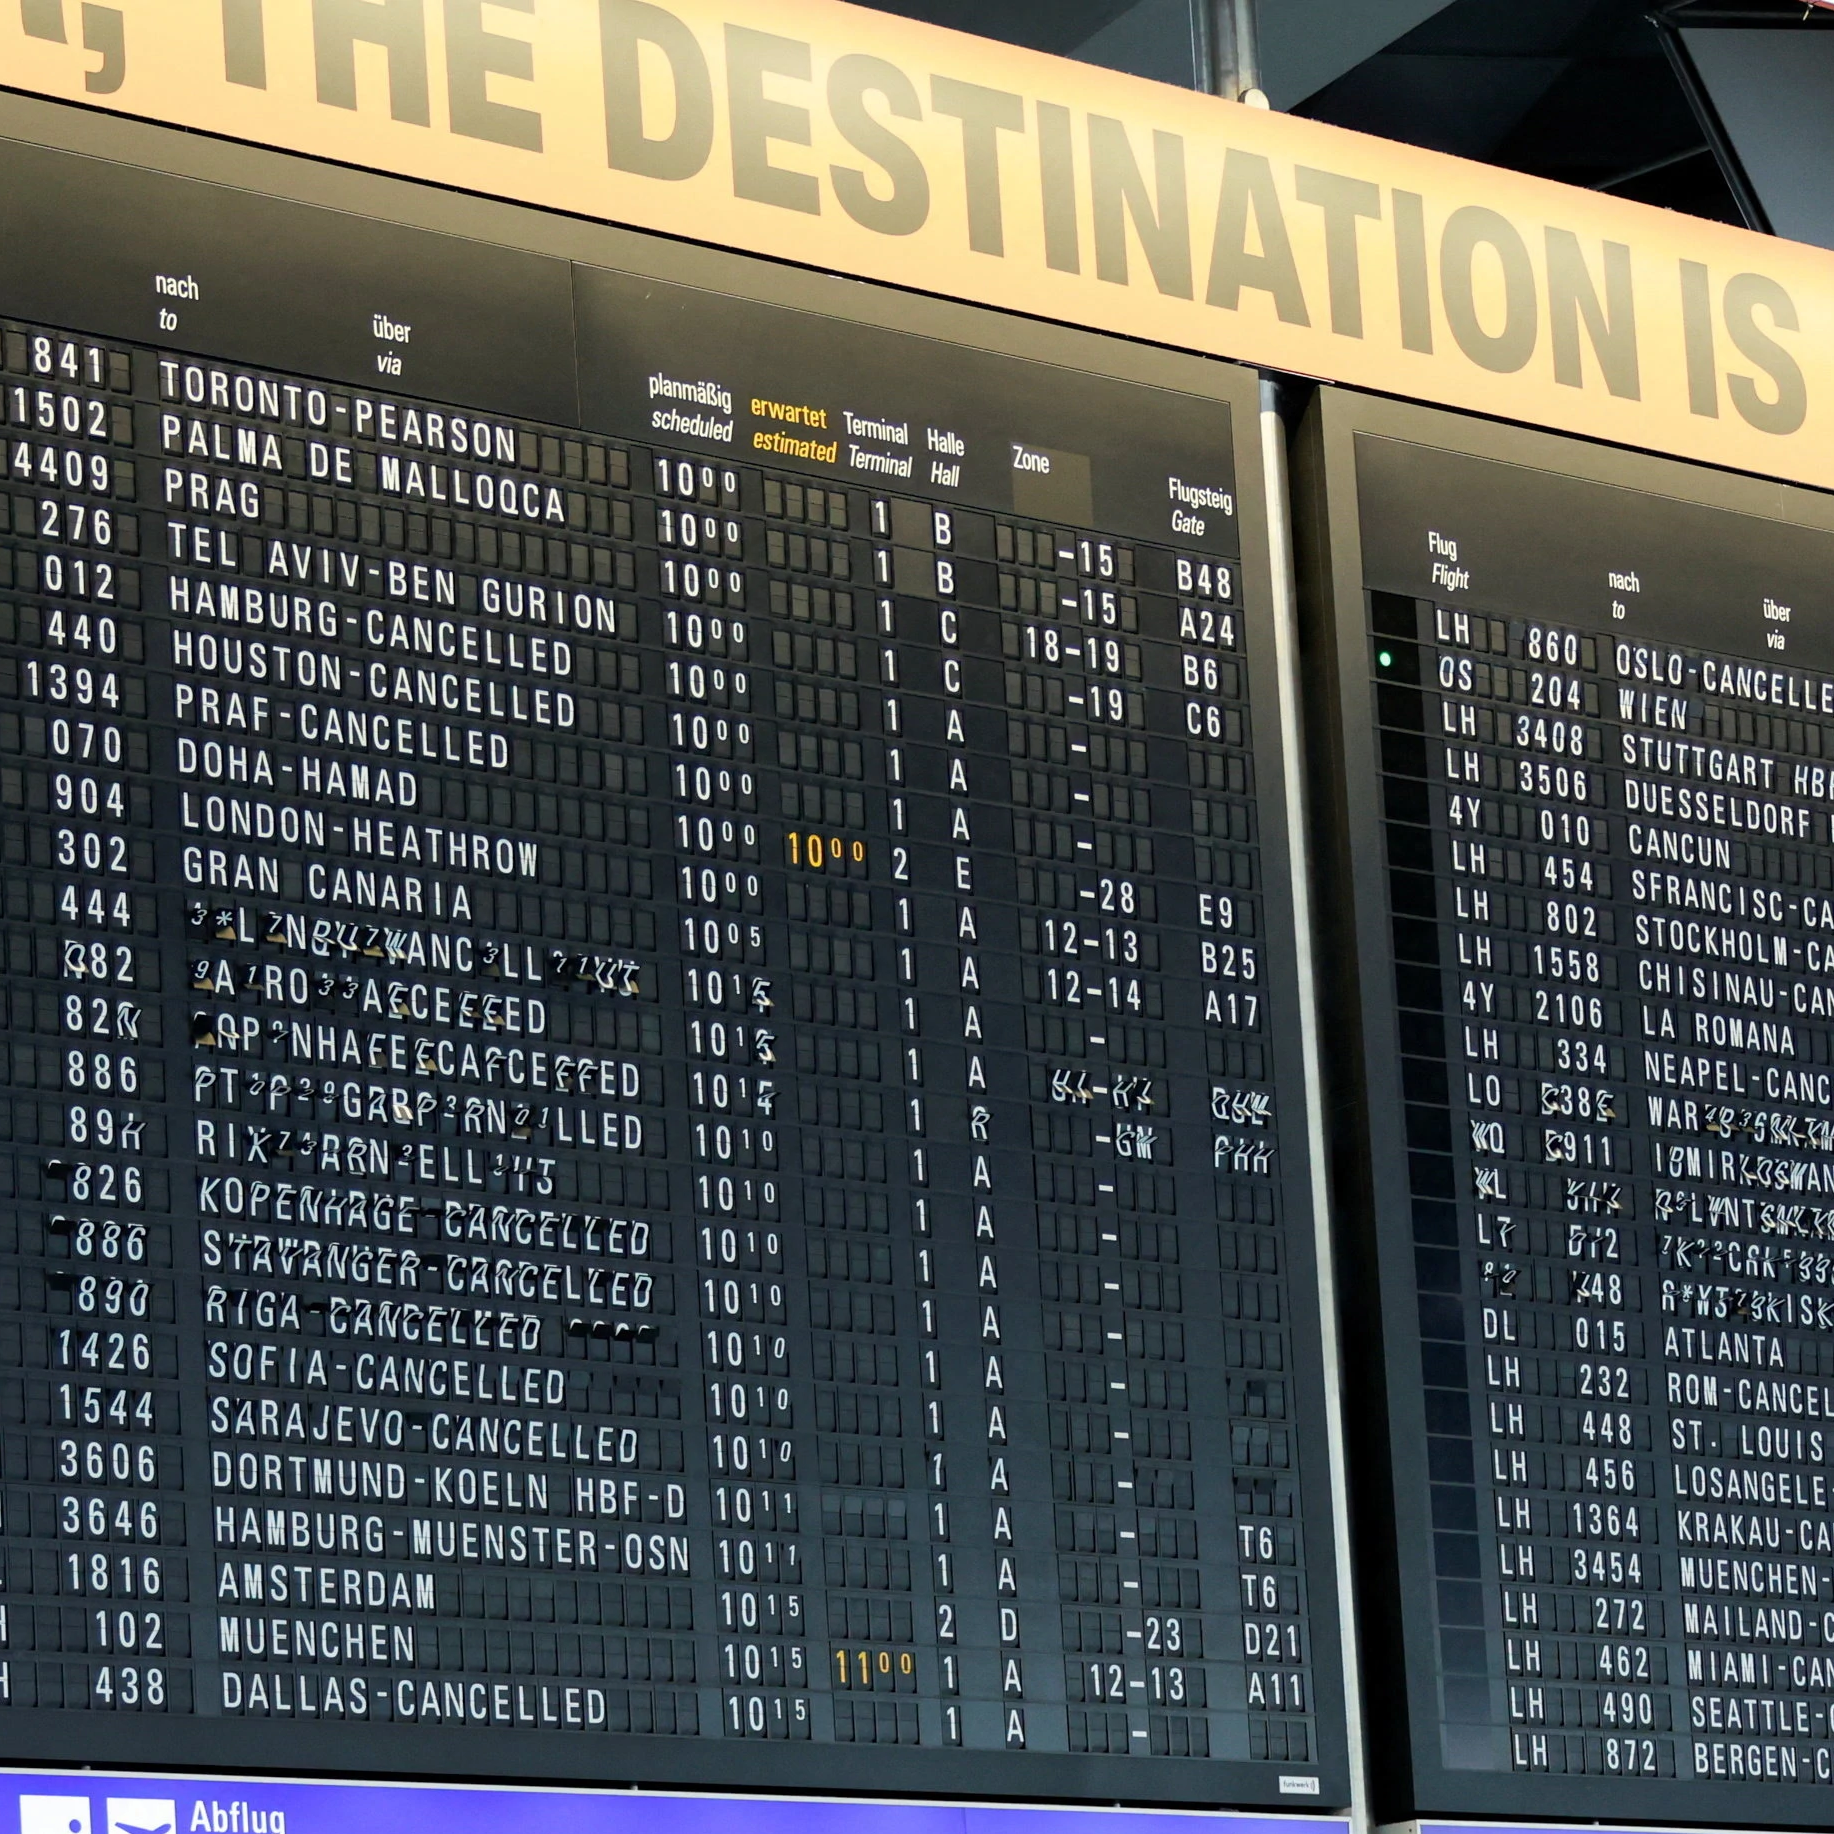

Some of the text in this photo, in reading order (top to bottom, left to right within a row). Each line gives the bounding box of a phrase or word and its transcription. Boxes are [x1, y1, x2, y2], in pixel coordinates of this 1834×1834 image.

[598, 0, 1641, 402] DESTINATION
[1678, 257, 1808, 436] IS
[156, 275, 198, 300] nach
[160, 309, 177, 330] to
[374, 314, 410, 342] über
[378, 351, 401, 375] via
[650, 373, 731, 414] planmäßig
[652, 408, 733, 442] scheduled
[752, 399, 826, 428] erwartet
[843, 412, 908, 445] Terminal
[754, 429, 837, 463] estimated
[928, 428, 964, 456] Halle
[1013, 446, 1049, 473] Zone
[35, 337, 103, 382] 841
[161, 361, 514, 461] TORONTO-PEARSON
[1178, 559, 1230, 598] B48
[849, 445, 912, 477] Terminal
[931, 461, 959, 487] Hall
[166, 468, 258, 517] PRAG
[1169, 478, 1232, 516] Flugsteig
[1172, 509, 1204, 536] Gate
[1429, 532, 1457, 561] Flug
[168, 522, 614, 632] TEL AVIV-BEN GURION
[1433, 563, 1469, 591] Flight
[1609, 572, 1639, 592] nach
[1613, 601, 1625, 619] to
[1764, 599, 1790, 622] über
[1767, 630, 1785, 649] via
[174, 630, 573, 726] HOUSTON-CANCELLED
[1619, 689, 1686, 729] WIEN
[179, 738, 416, 806] DOHA-HAMAD
[1623, 734, 1773, 788] STUTTGART
[1626, 780, 1808, 837] DUESSELDORF
[184, 792, 536, 876] LONDON-HEATHROW
[1630, 825, 1729, 868] CANCUN
[184, 847, 471, 919] GRAN CANARIA
[1665, 1327, 1783, 1366] ATLANTA
[1673, 1419, 1716, 1449] ST.
[1742, 1425, 1822, 1461] LOUIS
[217, 1507, 688, 1570] HAMBURG-MUENSTER-OSN
[219, 1563, 1296, 1656] AMSTERDAM D21
[221, 1617, 413, 1660] MUENCHEN
